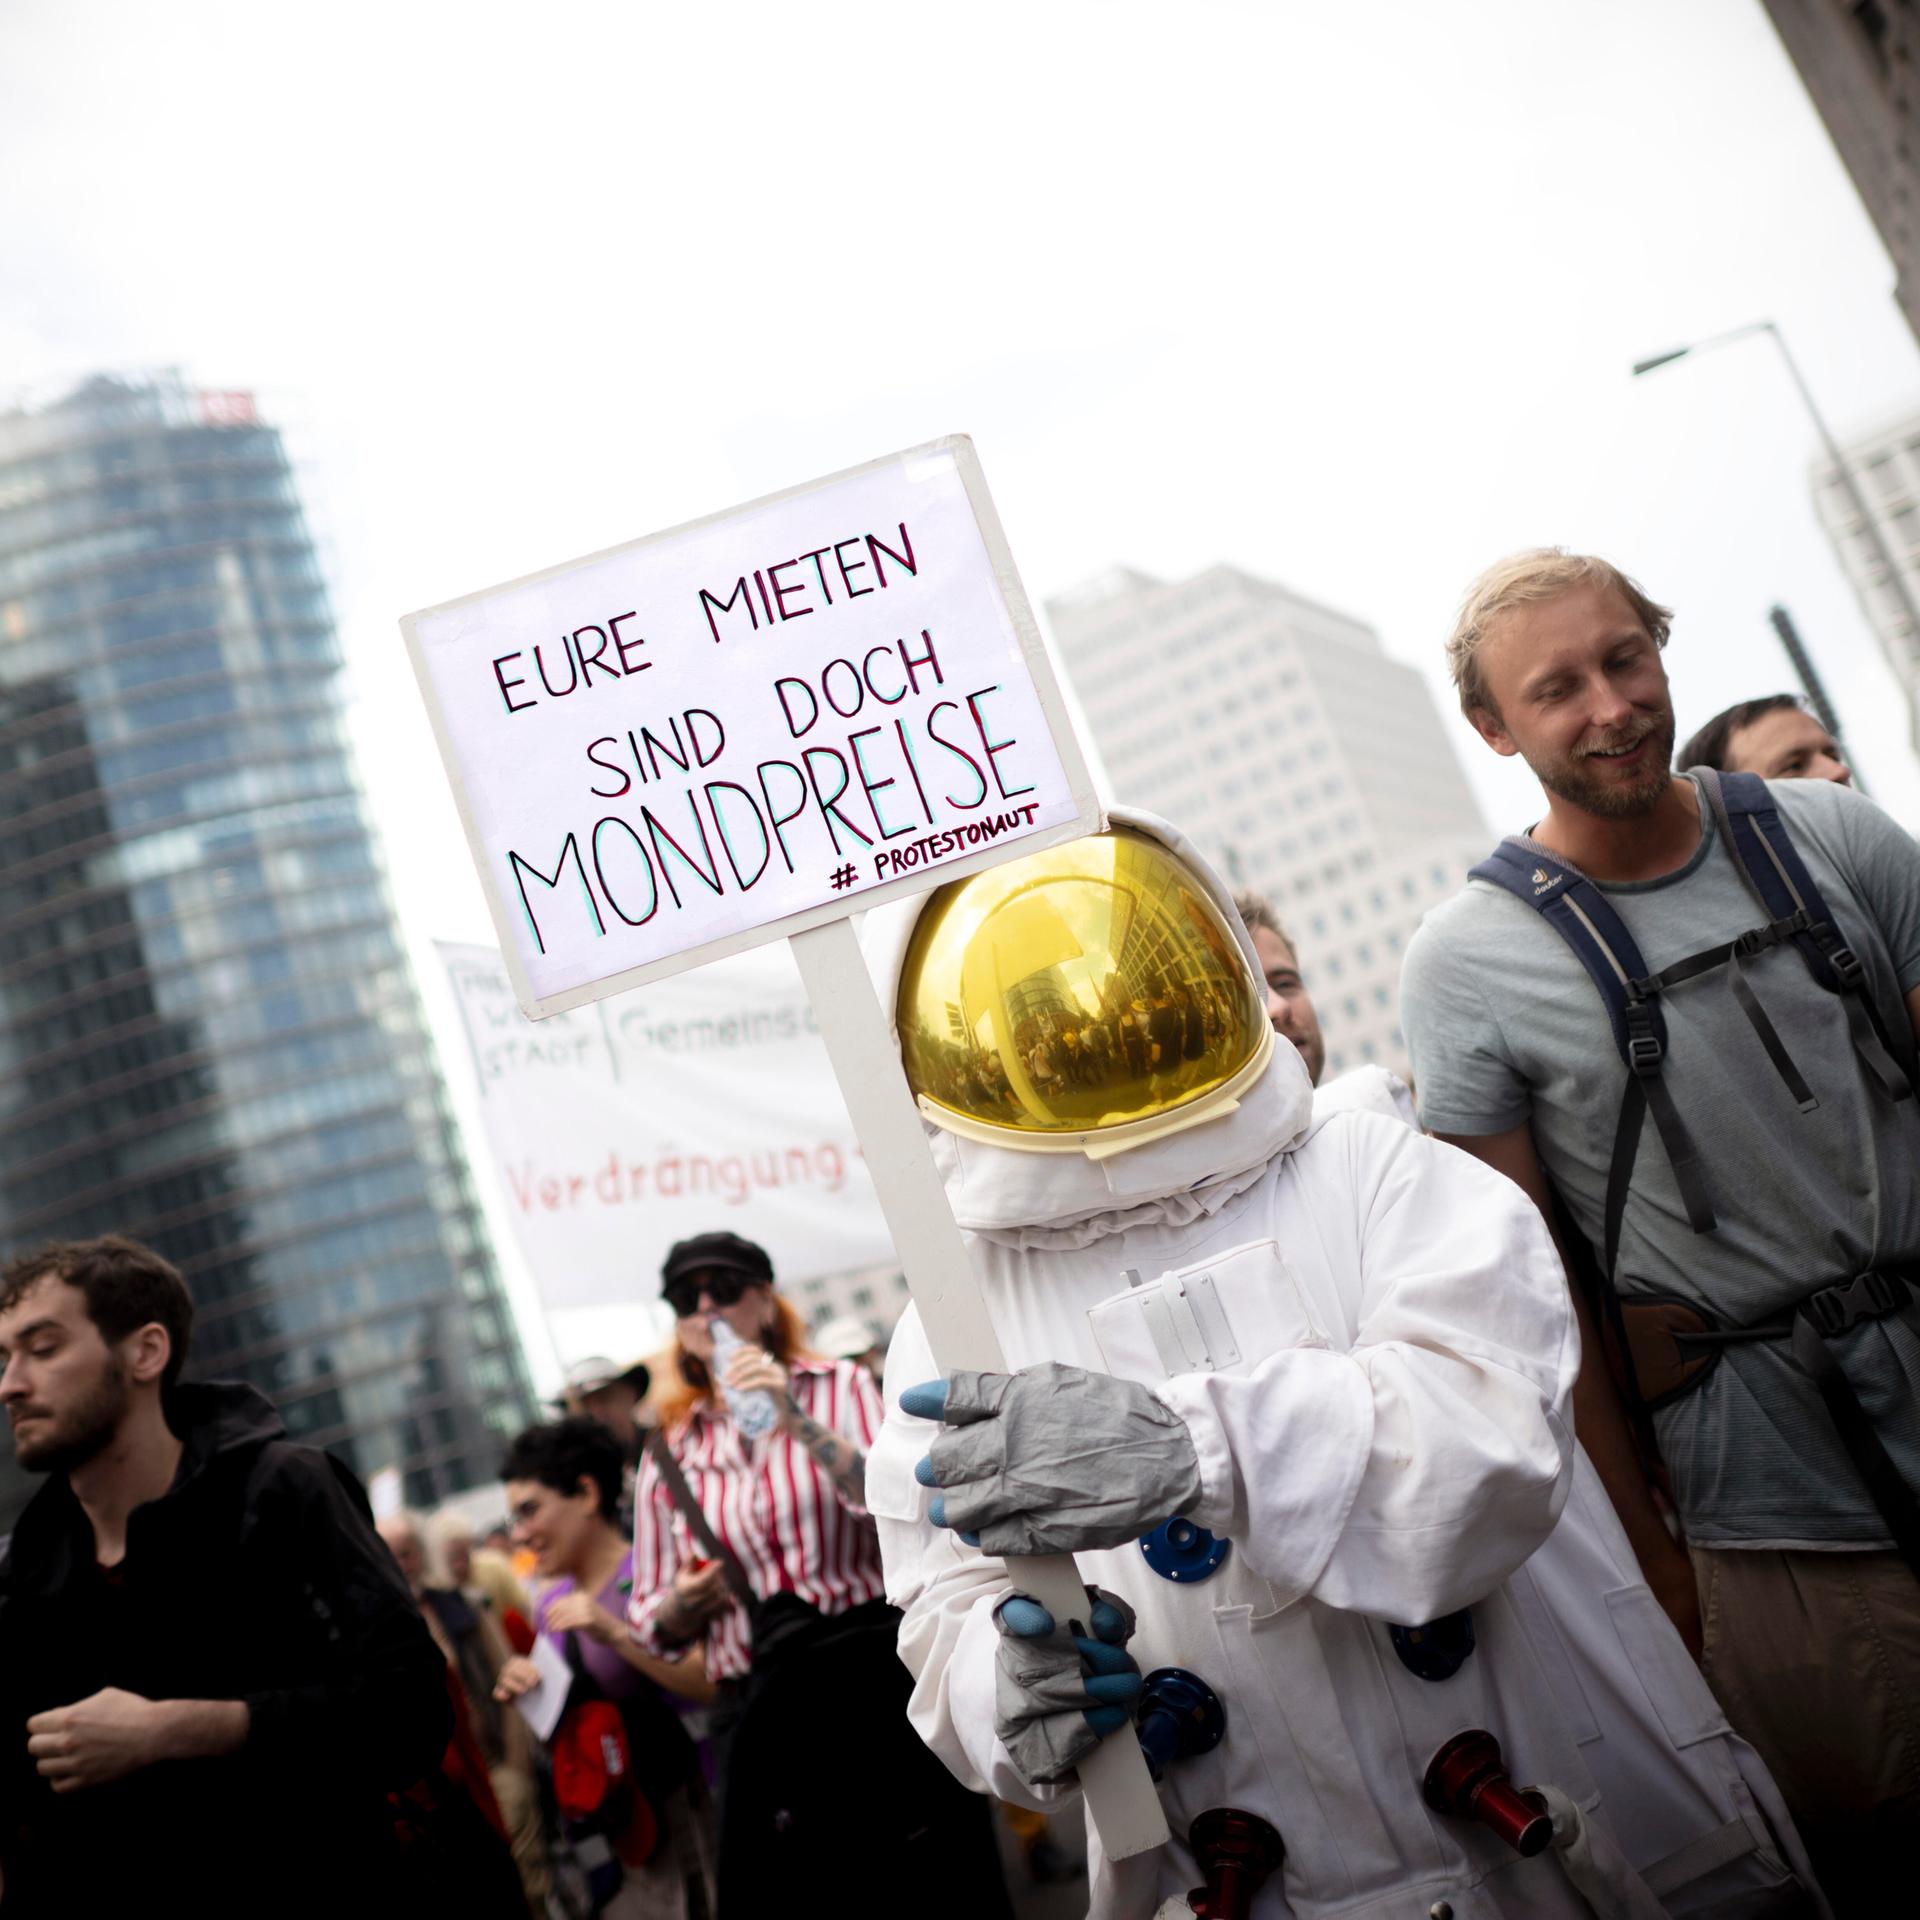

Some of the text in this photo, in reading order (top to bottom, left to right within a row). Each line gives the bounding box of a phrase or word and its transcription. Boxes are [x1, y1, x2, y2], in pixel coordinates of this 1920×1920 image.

[493, 523, 917, 713] EURE MIETEN
[586, 629, 944, 798] SIND DOCH
[507, 686, 1038, 955] MONDPREISE
[873, 803, 1040, 880] PROTESTONAUT
[1535, 874, 1563, 896] deuter
[506, 1140, 848, 1213] Verdrängung
